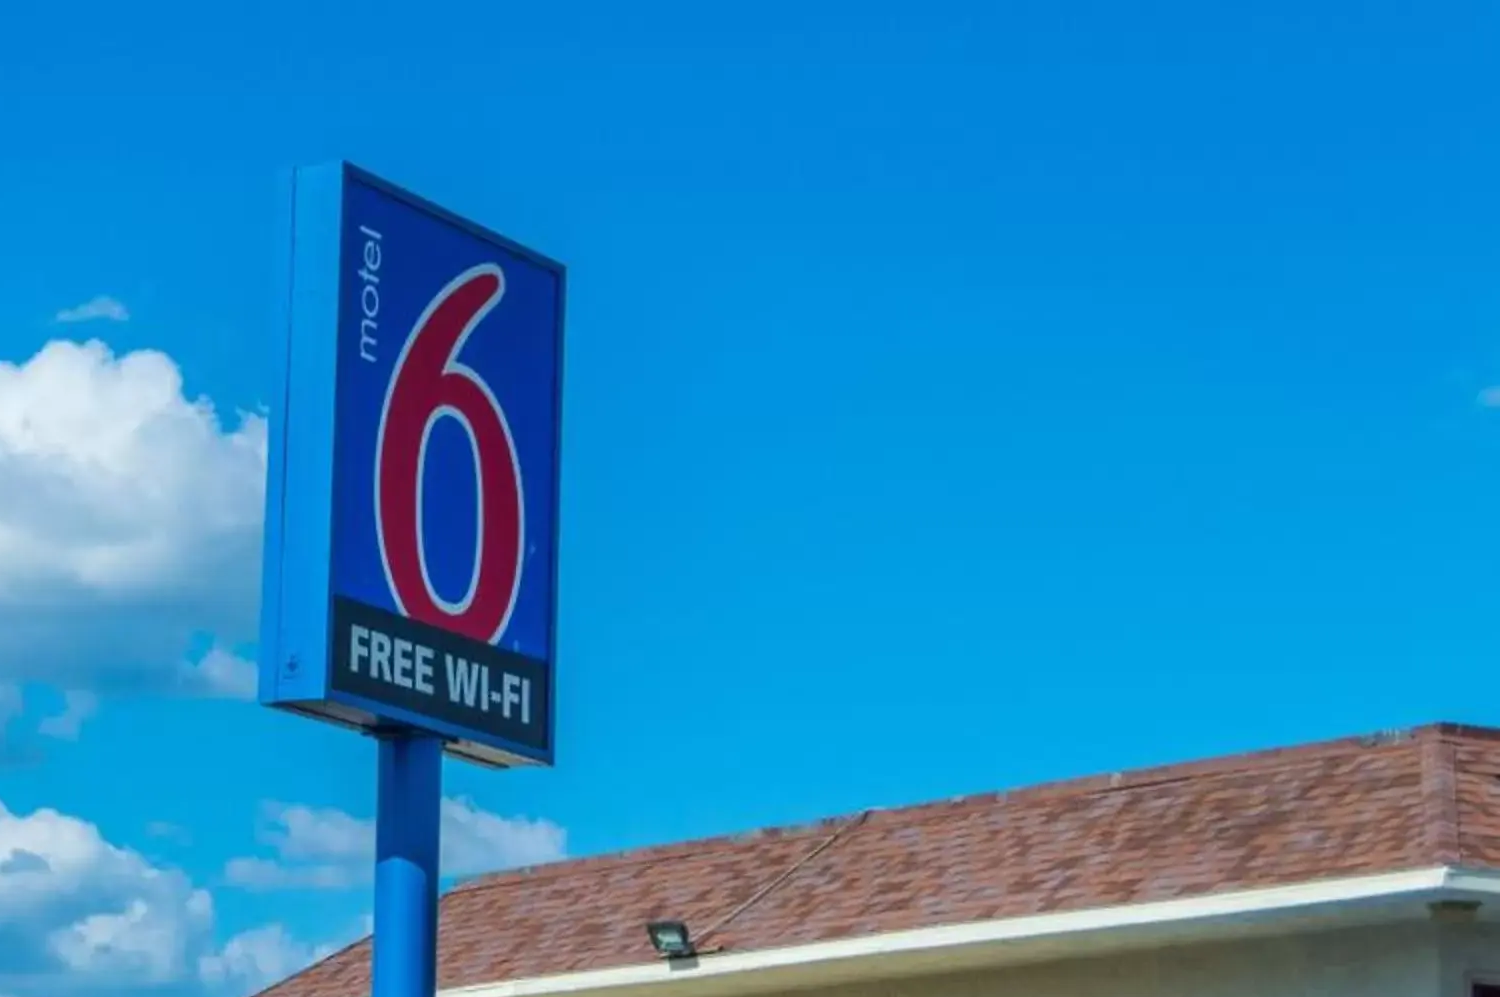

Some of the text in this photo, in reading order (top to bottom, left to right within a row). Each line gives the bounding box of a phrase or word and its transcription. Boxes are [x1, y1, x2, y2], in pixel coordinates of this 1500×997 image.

[358, 225, 383, 363] motel
[374, 262, 525, 646] 6
[350, 623, 531, 725] FREE WI-FI
